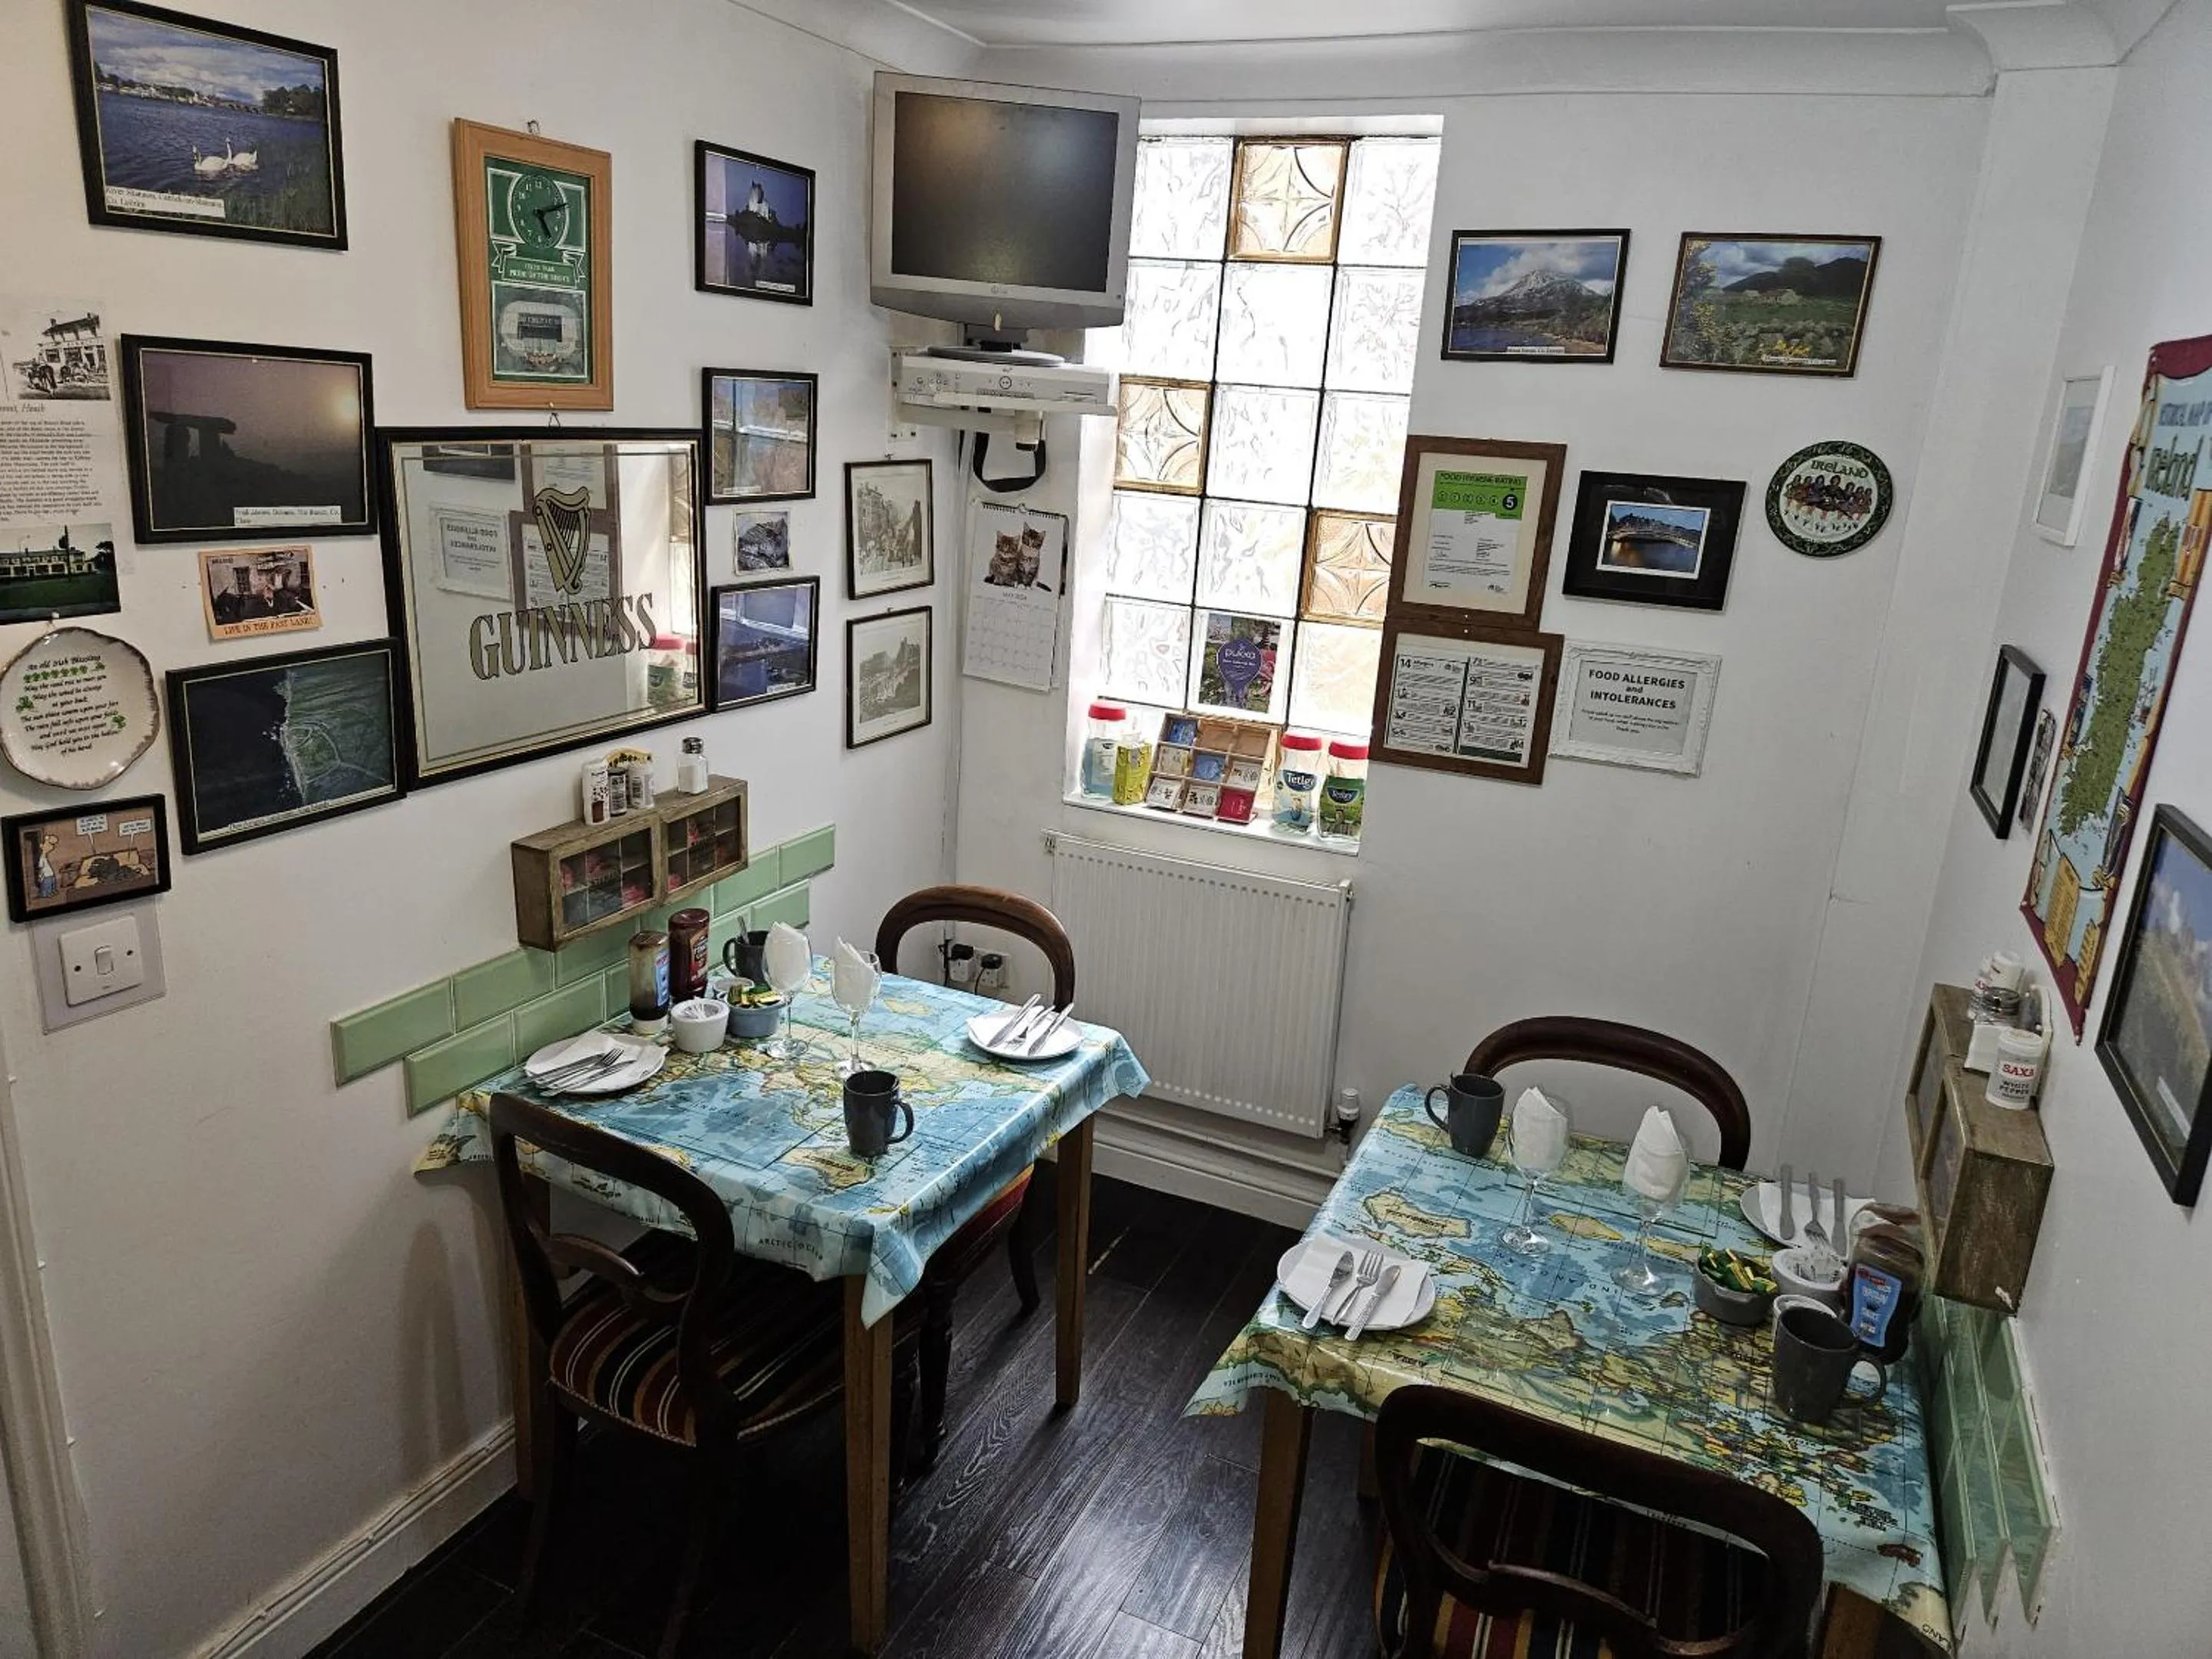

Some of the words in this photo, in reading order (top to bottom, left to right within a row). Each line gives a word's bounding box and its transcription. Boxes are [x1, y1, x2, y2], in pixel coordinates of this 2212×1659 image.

[1811, 460, 1869, 479] IRELAND
[1506, 497, 1516, 508] 5
[468, 593, 657, 680] GUINNESS
[1400, 659, 1411, 669] 14
[1589, 669, 1620, 681] FOOD
[1622, 673, 1685, 689] ALLERGIES
[1590, 690, 1676, 709] INTOLERANCES
